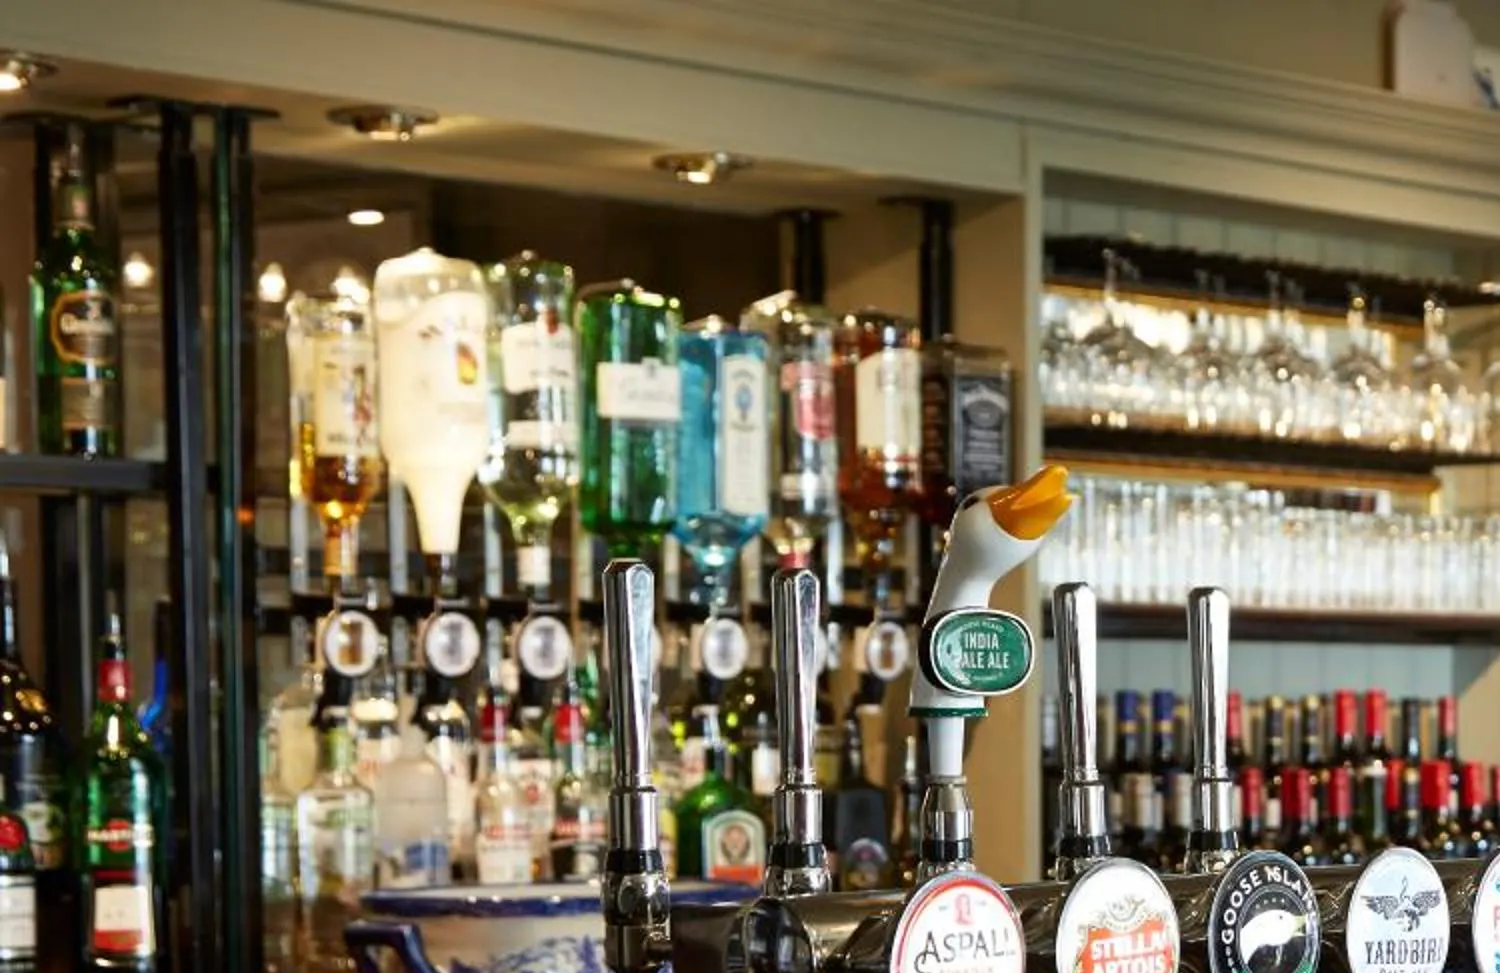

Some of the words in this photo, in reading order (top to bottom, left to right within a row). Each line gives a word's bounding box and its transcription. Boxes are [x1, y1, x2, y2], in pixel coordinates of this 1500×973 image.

[965, 631, 1000, 649] INDIA
[961, 651, 985, 669] ALE
[987, 651, 1010, 669] ALE
[1221, 871, 1263, 944] GOOSE
[1091, 930, 1166, 960] STELLA
